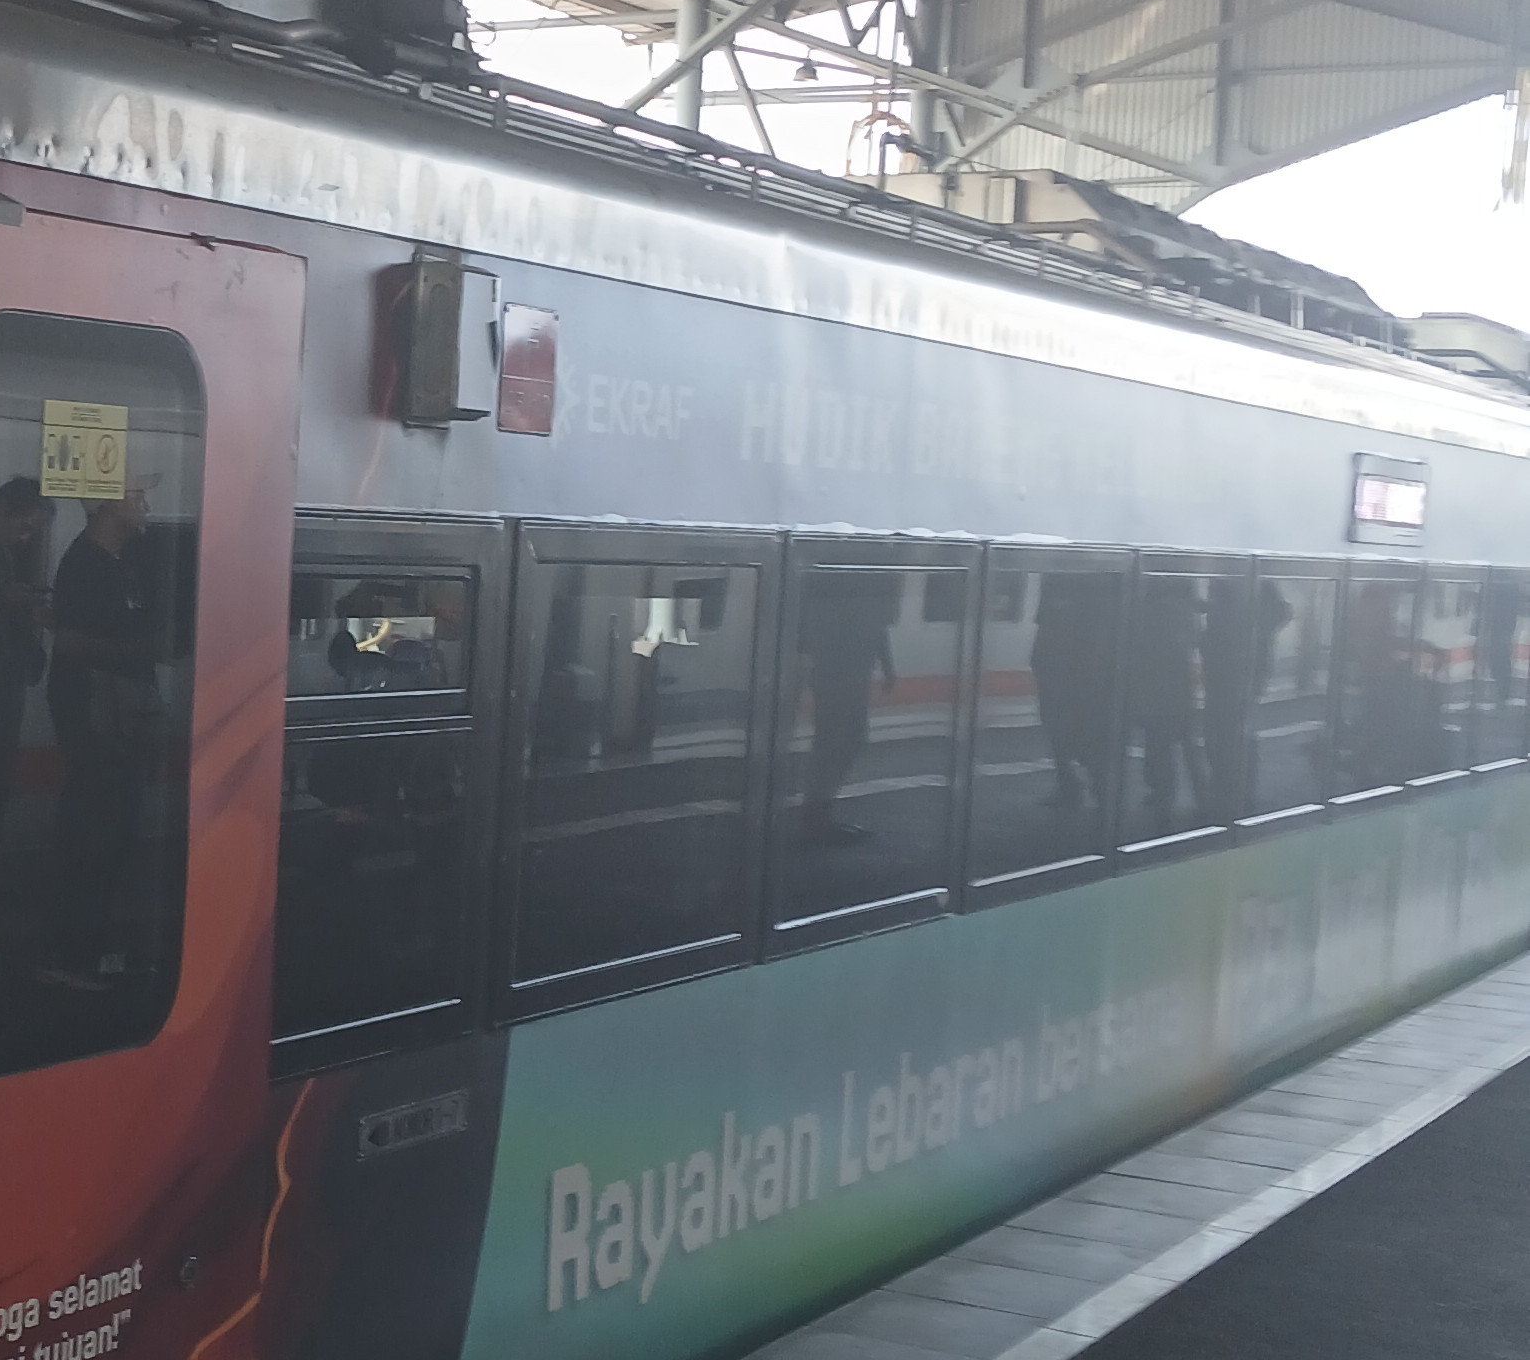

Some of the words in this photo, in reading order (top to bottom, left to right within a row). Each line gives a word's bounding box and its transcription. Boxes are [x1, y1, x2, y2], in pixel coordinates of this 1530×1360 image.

[587, 373, 696, 441] EKRAF
[546, 1110, 820, 1312] Rayakan
[837, 1051, 1024, 1186] Lebaran
[48, 1257, 143, 1320] selamat
